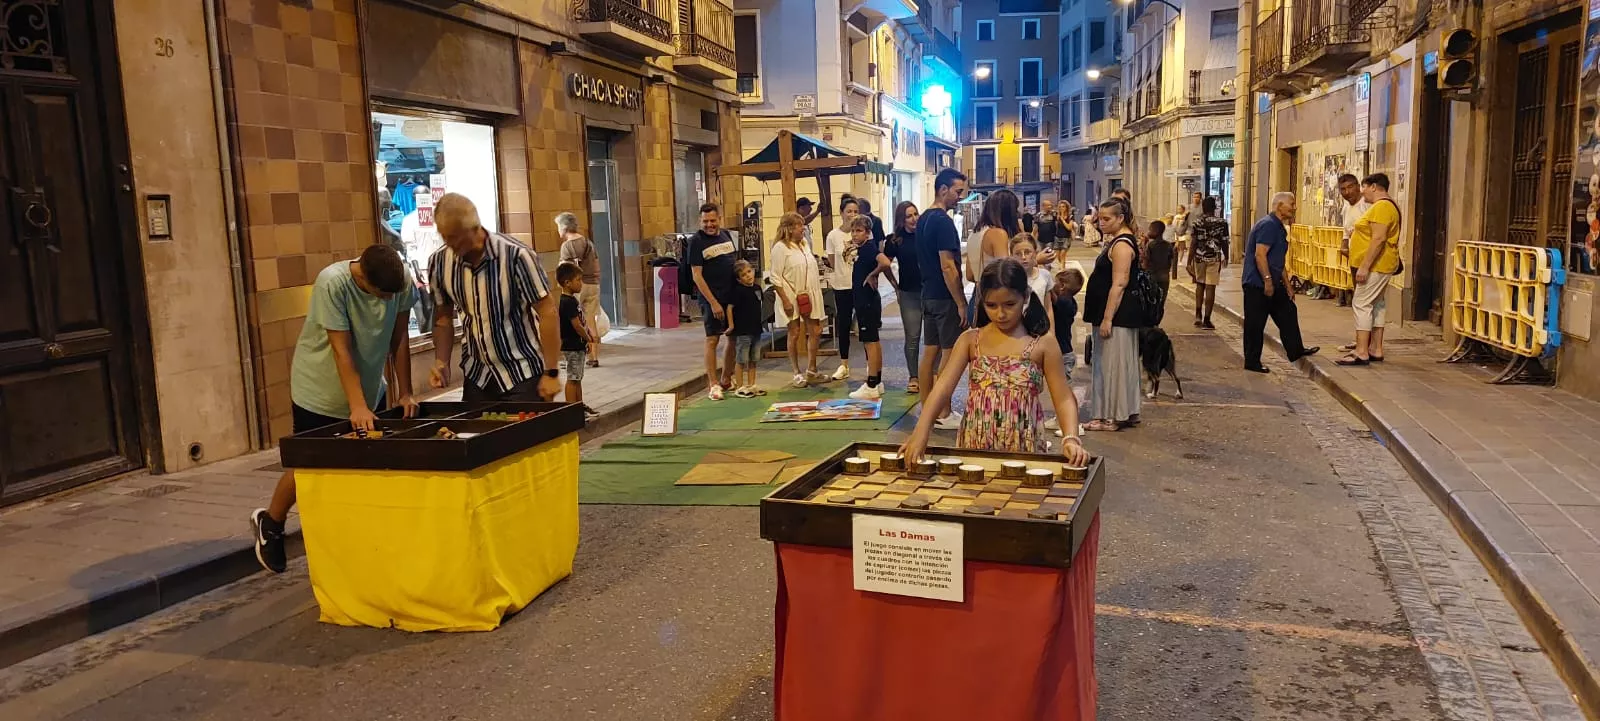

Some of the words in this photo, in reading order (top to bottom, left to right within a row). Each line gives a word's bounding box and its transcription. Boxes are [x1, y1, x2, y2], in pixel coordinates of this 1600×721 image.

[154, 37, 174, 58] 26
[572, 72, 613, 104] CHACA
[613, 82, 642, 109] SPORT
[1184, 118, 1235, 133] MISTE
[1215, 139, 1235, 149] Abri
[747, 207, 757, 218] P
[879, 529, 897, 538] Las
[900, 531, 936, 541] Damas
[893, 551, 917, 559] diagonal
